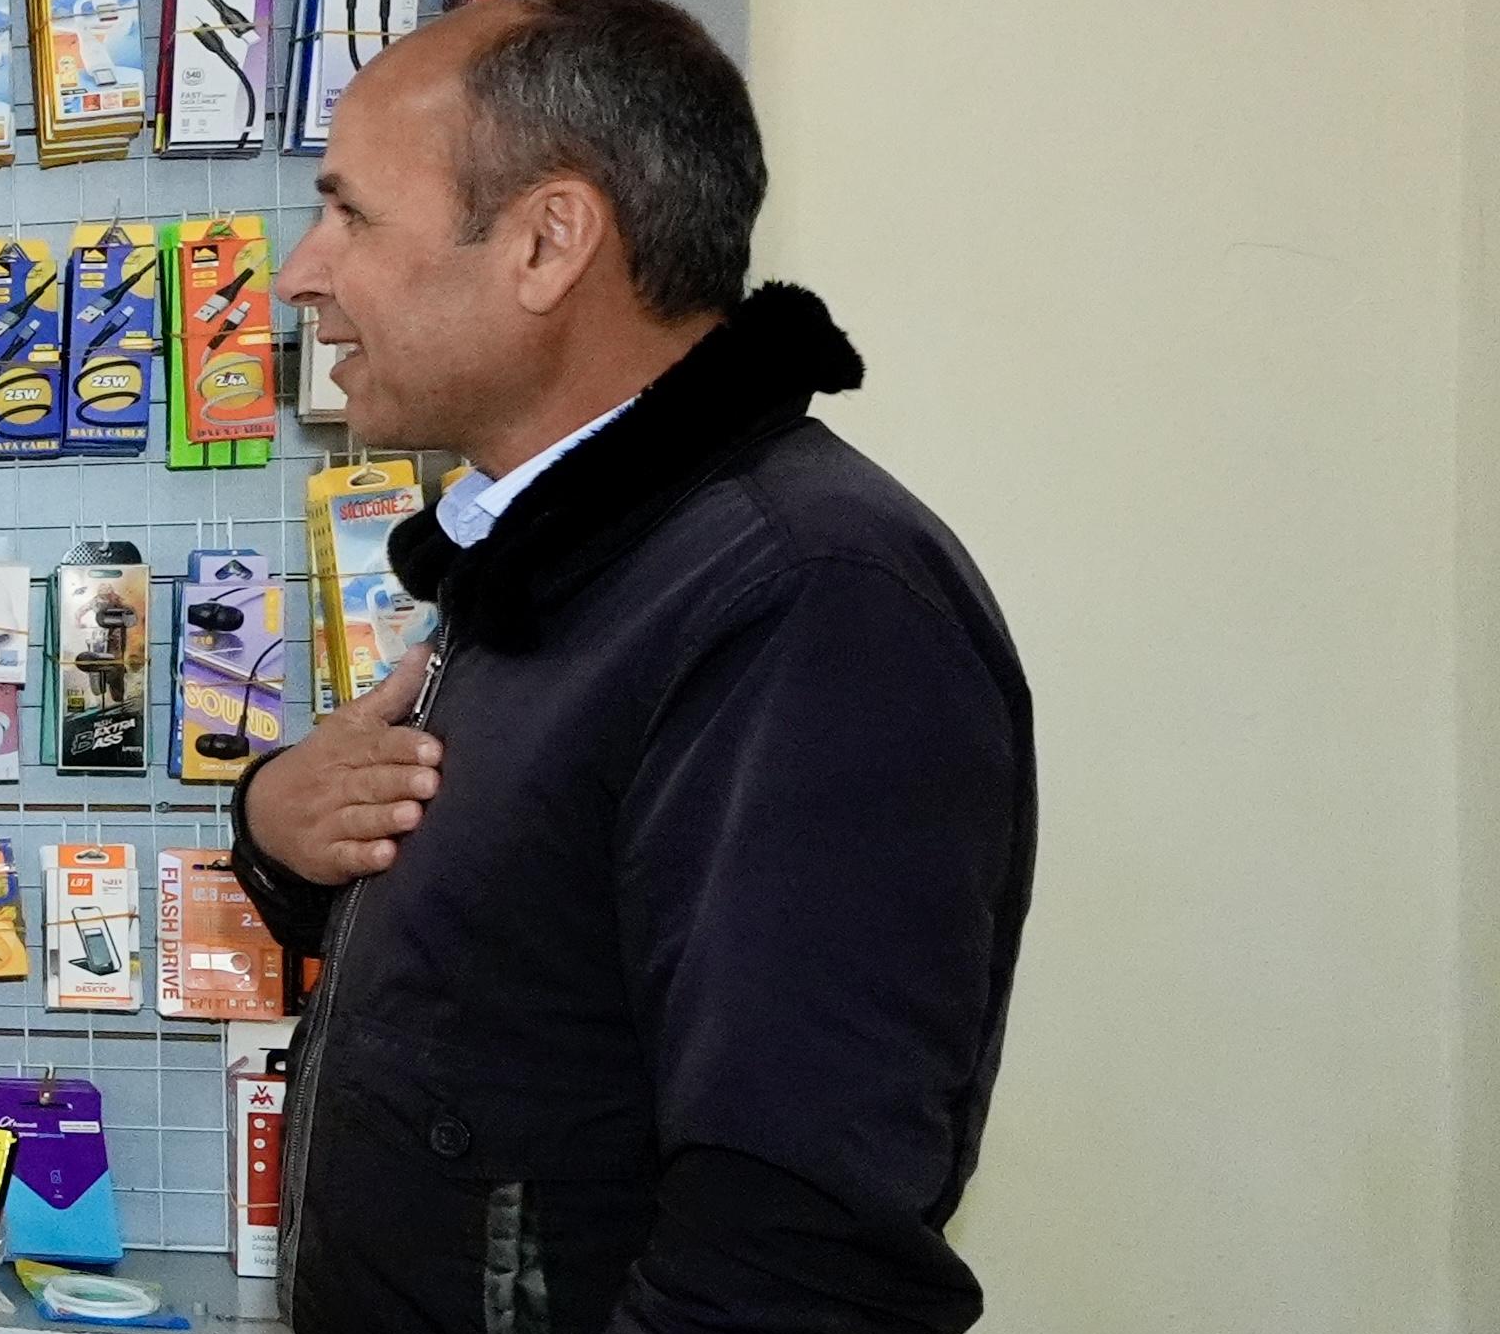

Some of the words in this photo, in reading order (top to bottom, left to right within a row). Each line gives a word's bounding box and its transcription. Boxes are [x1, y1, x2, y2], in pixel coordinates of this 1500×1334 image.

[92, 375, 129, 388] 25W
[4, 388, 41, 402] 25W
[68, 428, 105, 439] DATA
[106, 427, 146, 438] CABLE
[24, 440, 59, 451] CABLE
[185, 679, 279, 741] SOUND
[160, 866, 179, 934] FLASH
[161, 938, 181, 1000] DRIVE
[75, 985, 117, 994] DESKTOP
